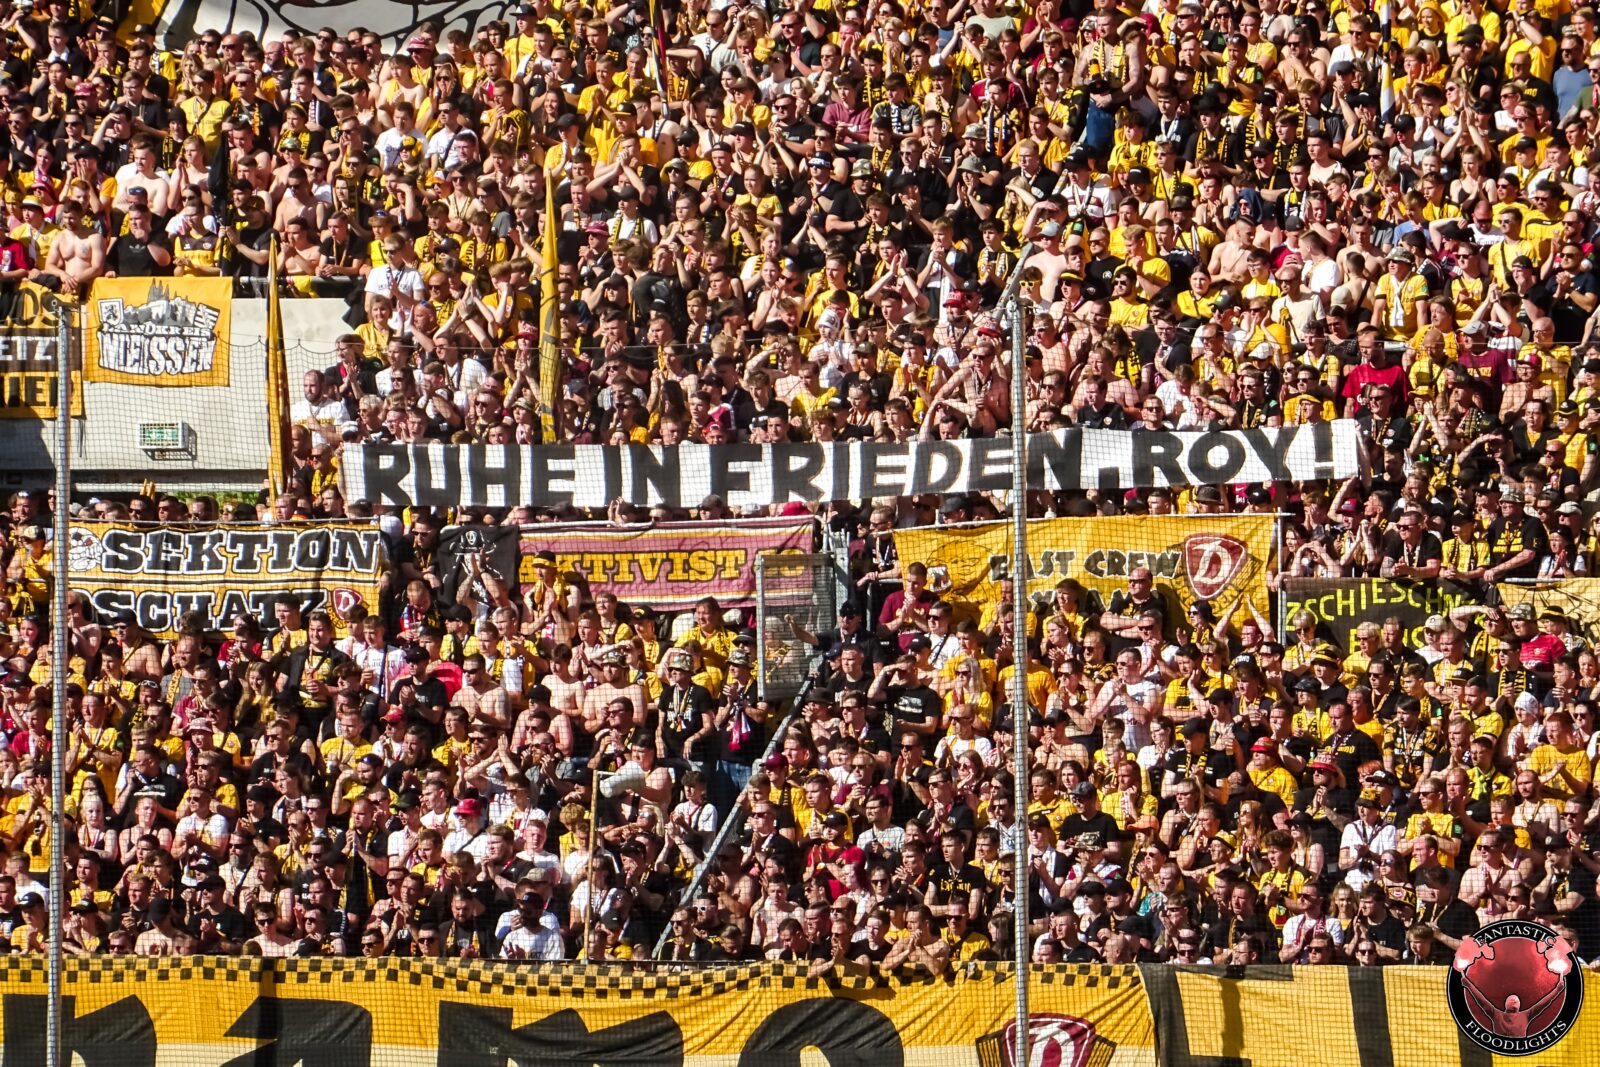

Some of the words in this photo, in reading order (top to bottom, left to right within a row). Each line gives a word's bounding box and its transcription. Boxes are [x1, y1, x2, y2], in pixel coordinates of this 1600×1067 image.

[103, 323, 211, 338] LANDKREIS
[98, 333, 215, 375] MEISSEN
[363, 444, 576, 507] RUHE
[603, 444, 681, 507] IN
[1132, 420, 1334, 487] ROY!
[101, 528, 380, 574] SEKTION
[1084, 549, 1182, 578] CREW
